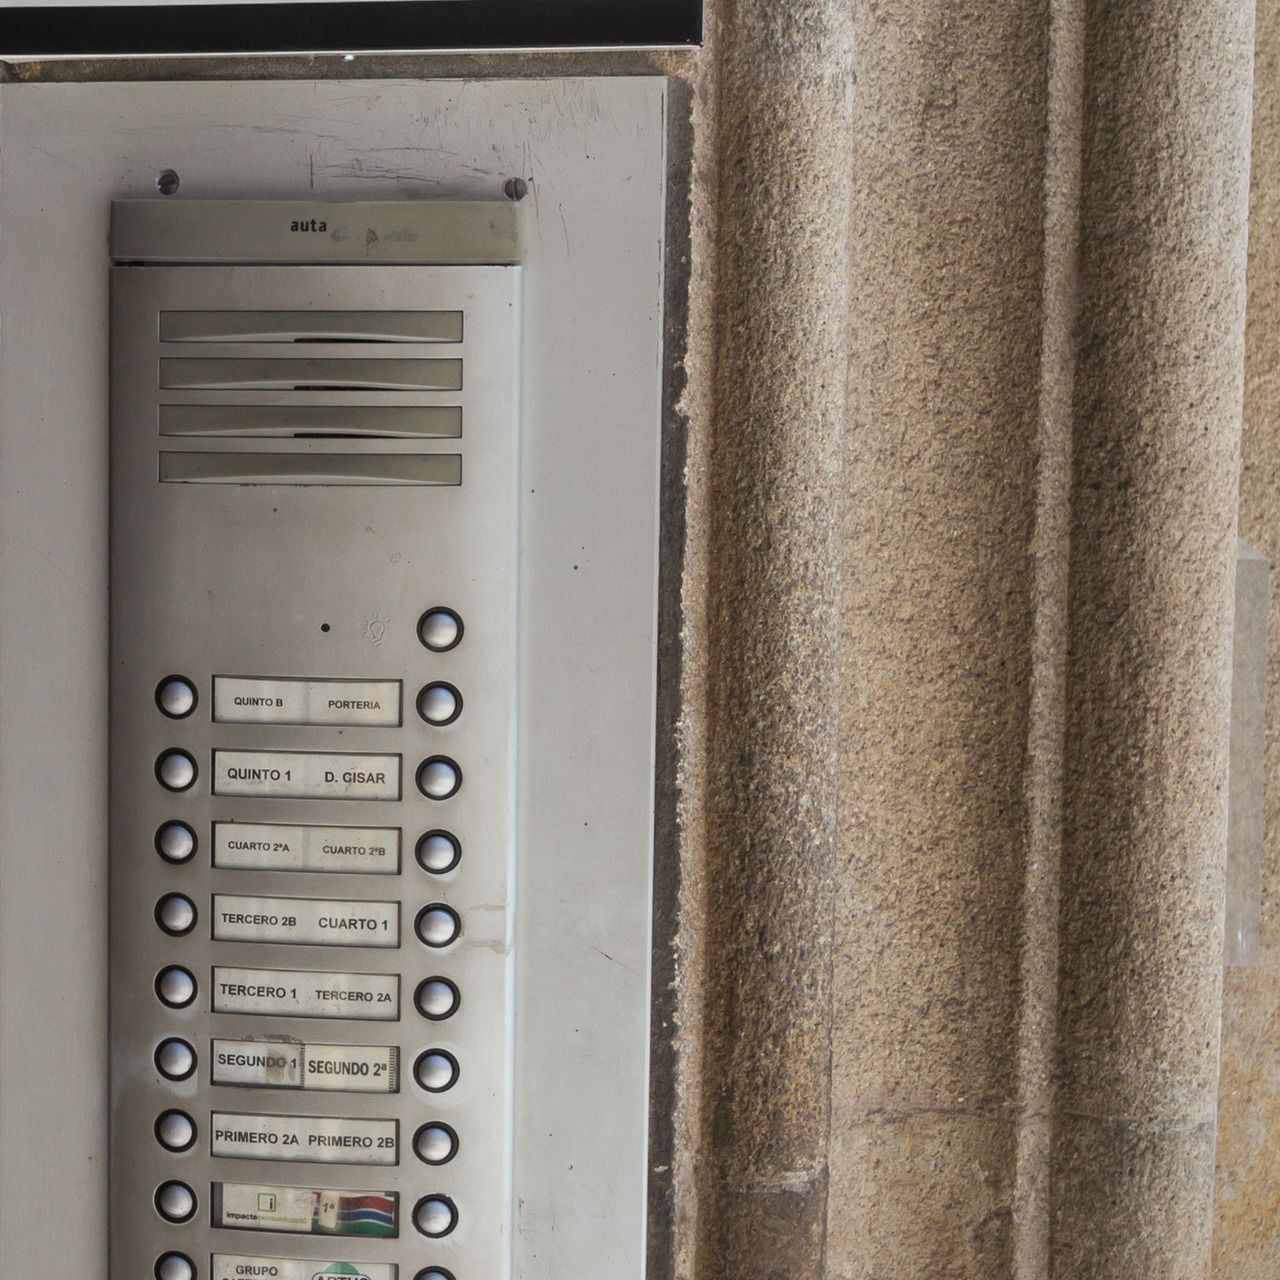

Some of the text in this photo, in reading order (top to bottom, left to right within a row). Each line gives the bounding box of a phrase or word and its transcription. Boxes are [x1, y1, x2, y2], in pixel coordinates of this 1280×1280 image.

[290, 219, 327, 233] auta
[234, 696, 283, 708] QUINTO B
[328, 699, 381, 710] PORTERIA
[227, 767, 291, 782] QUINTO 1
[324, 771, 339, 783] D.
[228, 841, 271, 851] CUARTO
[322, 845, 366, 855] CUARTO
[221, 913, 297, 927] TERCERO 2B
[318, 917, 388, 930] CUARTO 1
[220, 984, 297, 998] TERCERO 1
[316, 989, 392, 1002] TERCERO 2A
[218, 1054, 297, 1069] SEGUNDO 1
[308, 1059, 369, 1075] SEGUNDO
[215, 1130, 299, 1145] PRIMERO 2A
[308, 1135, 394, 1148] PRIMERO 2B
[235, 1265, 278, 1277] GRUPO
